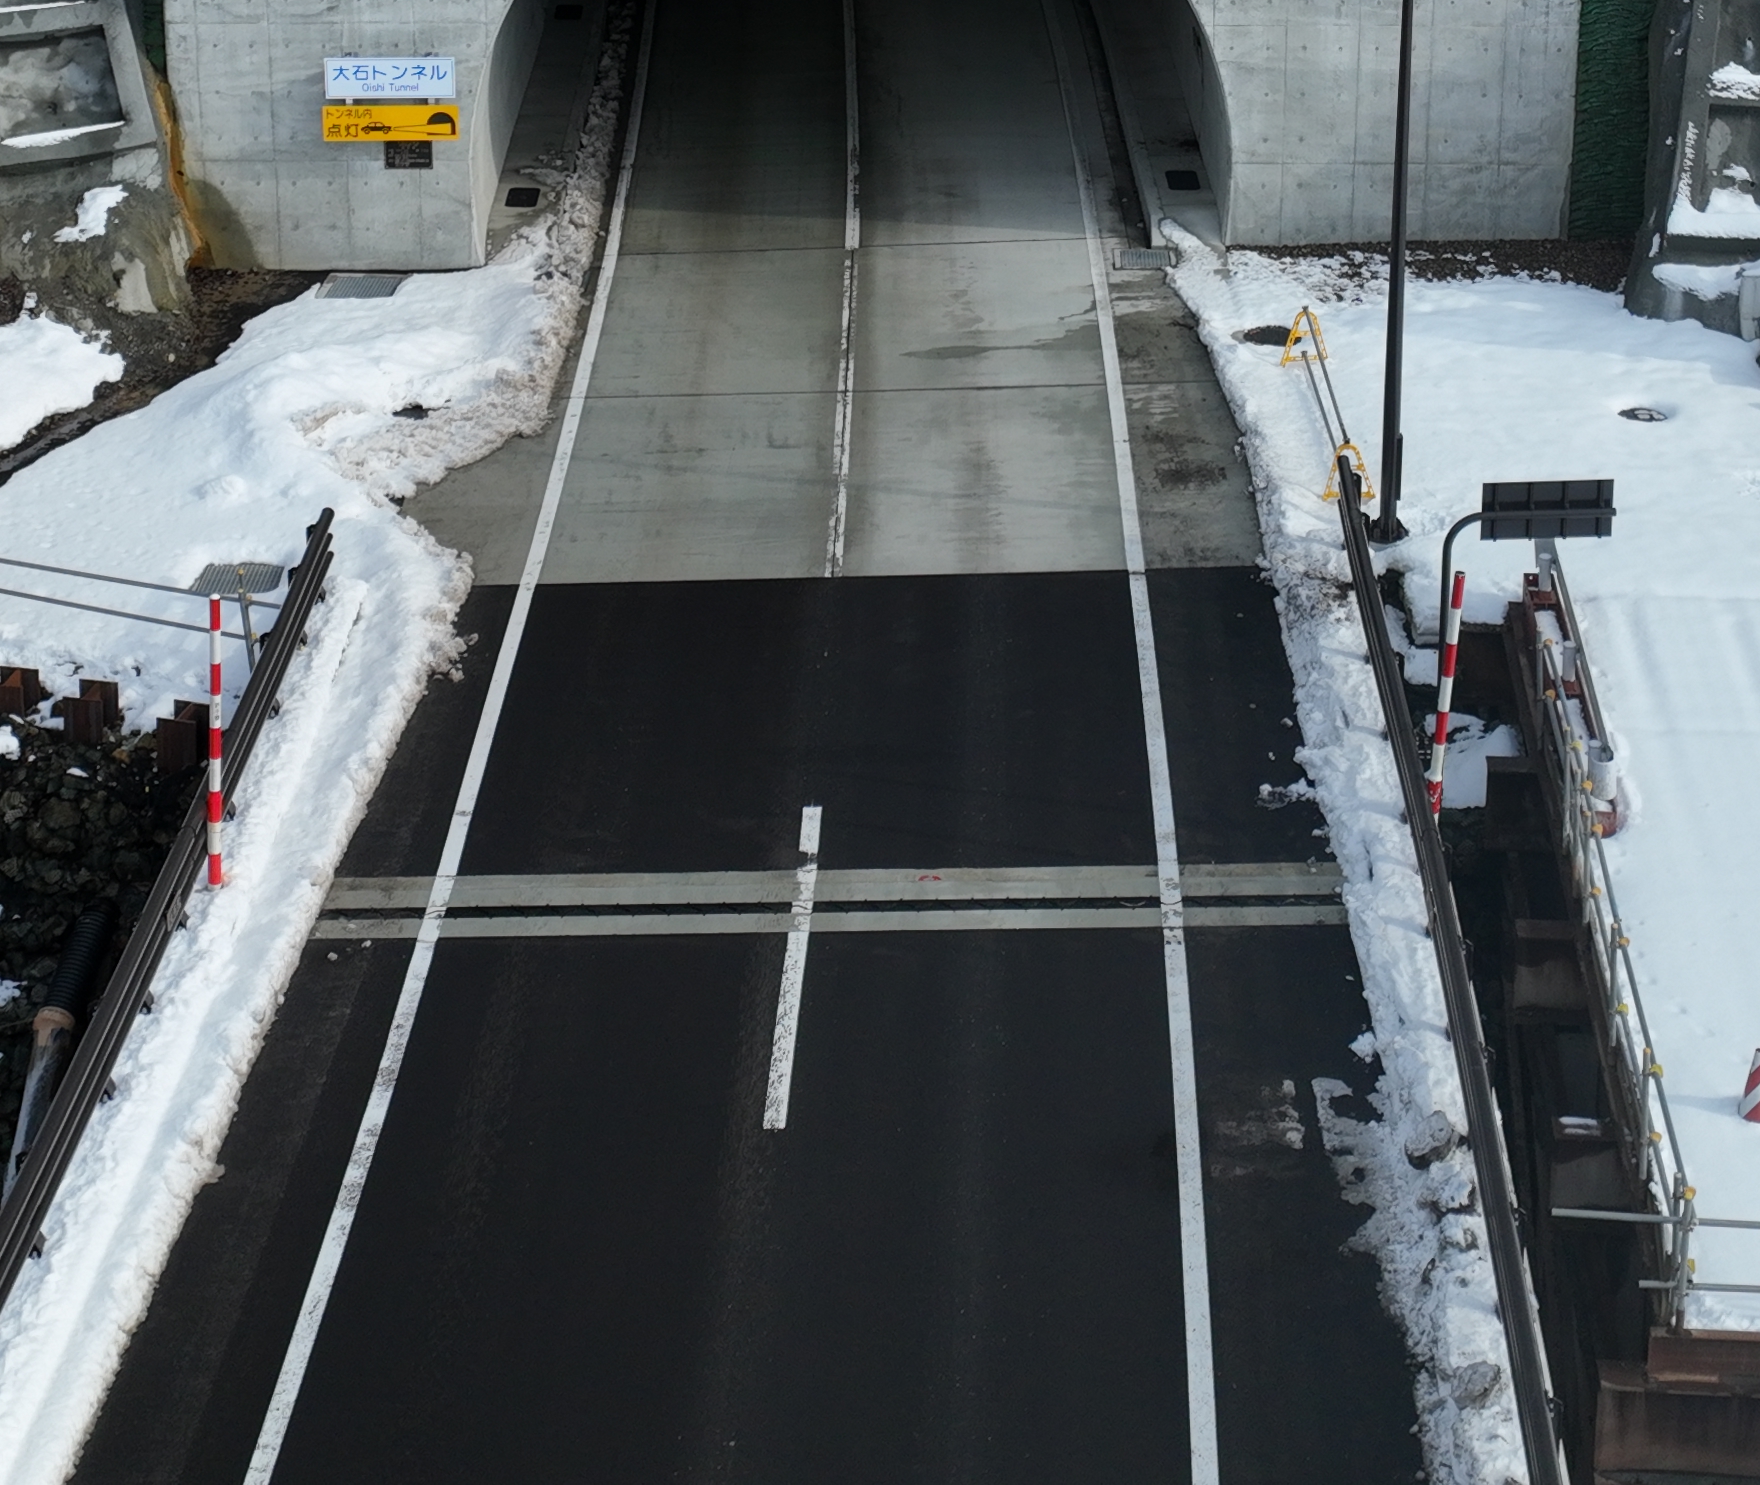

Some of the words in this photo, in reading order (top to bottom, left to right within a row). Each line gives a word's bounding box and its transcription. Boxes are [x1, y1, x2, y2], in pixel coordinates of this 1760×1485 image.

[332, 64, 447, 81] 大石トンネル
[362, 83, 385, 92] Oishi
[388, 82, 419, 92] Tunnel
[326, 108, 373, 119] トンネル内
[326, 123, 359, 138] 点灯
